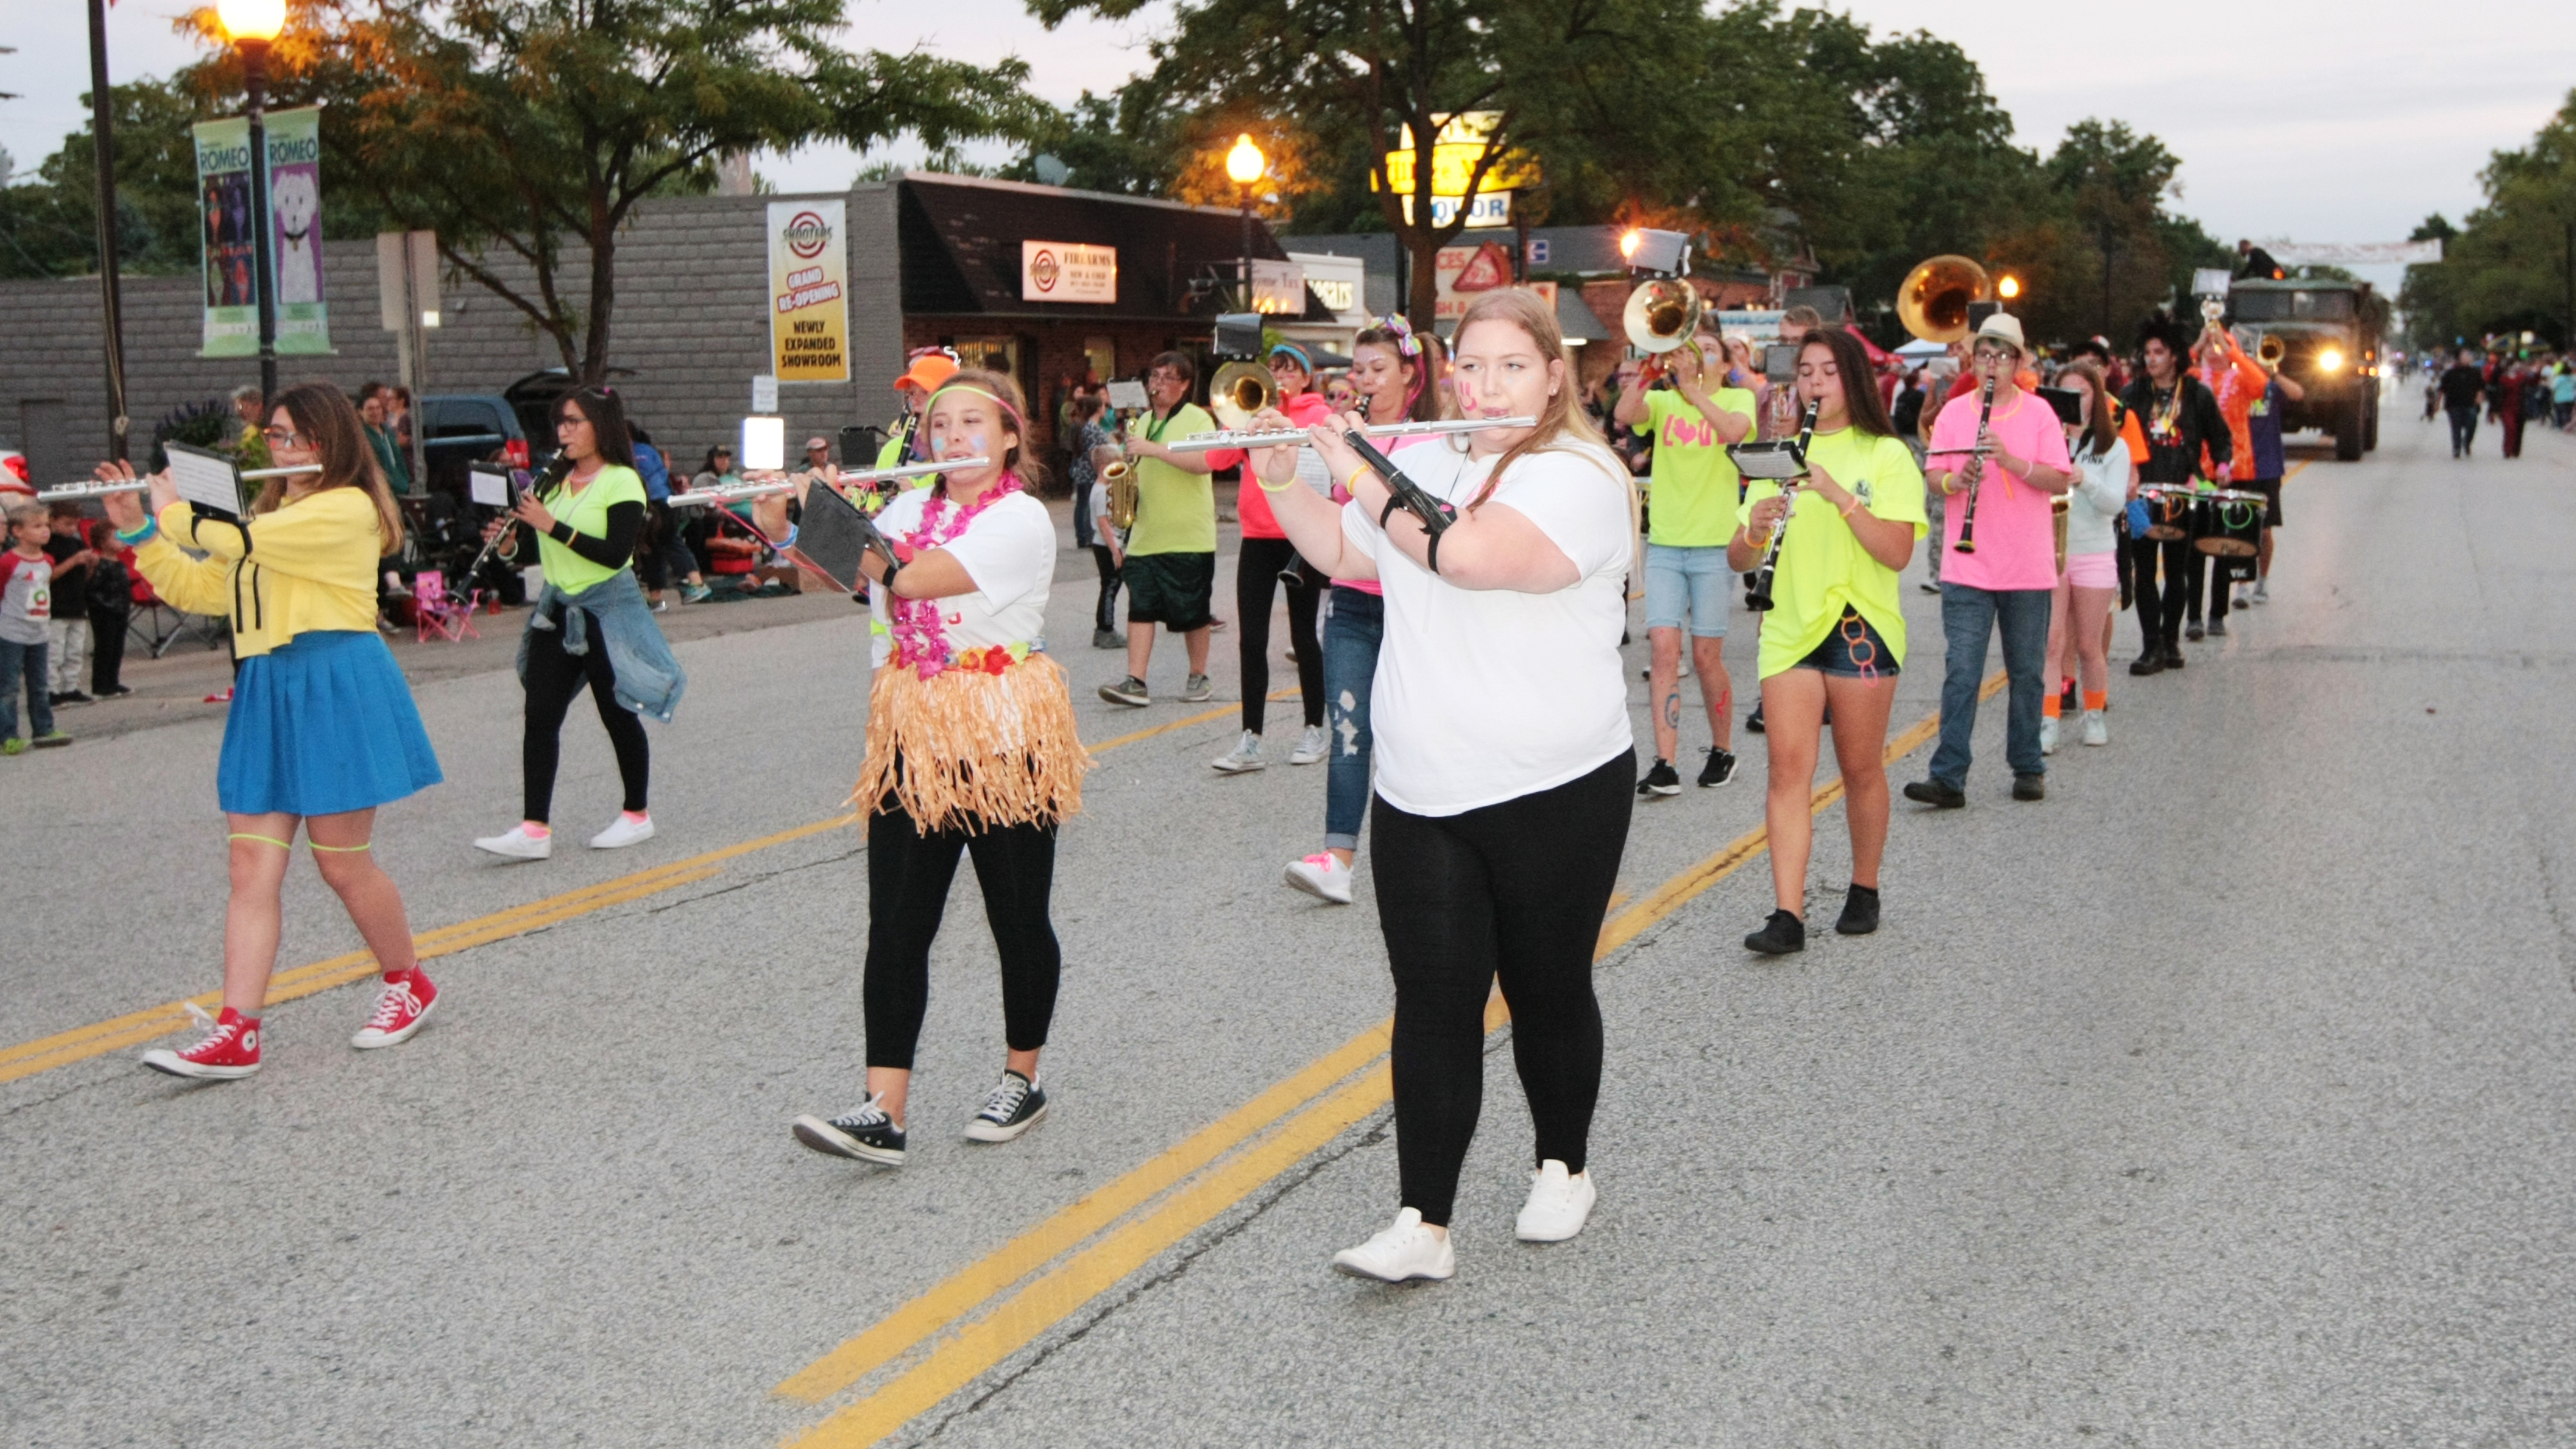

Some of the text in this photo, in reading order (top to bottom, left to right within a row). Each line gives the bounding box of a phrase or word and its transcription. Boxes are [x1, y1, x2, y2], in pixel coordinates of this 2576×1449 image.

[270, 136, 317, 163] ROMEO
[200, 147, 249, 171] ROMEO
[783, 226, 833, 242] SHOOTERS
[1063, 252, 1111, 267] FIREARMS
[788, 267, 822, 289] GRAND
[778, 281, 840, 312] RE-OPENING
[794, 320, 825, 334] NEWLY
[784, 337, 835, 351] EXPANDED
[781, 353, 841, 368] SHOWROOM
[2081, 454, 2104, 465] PINK
